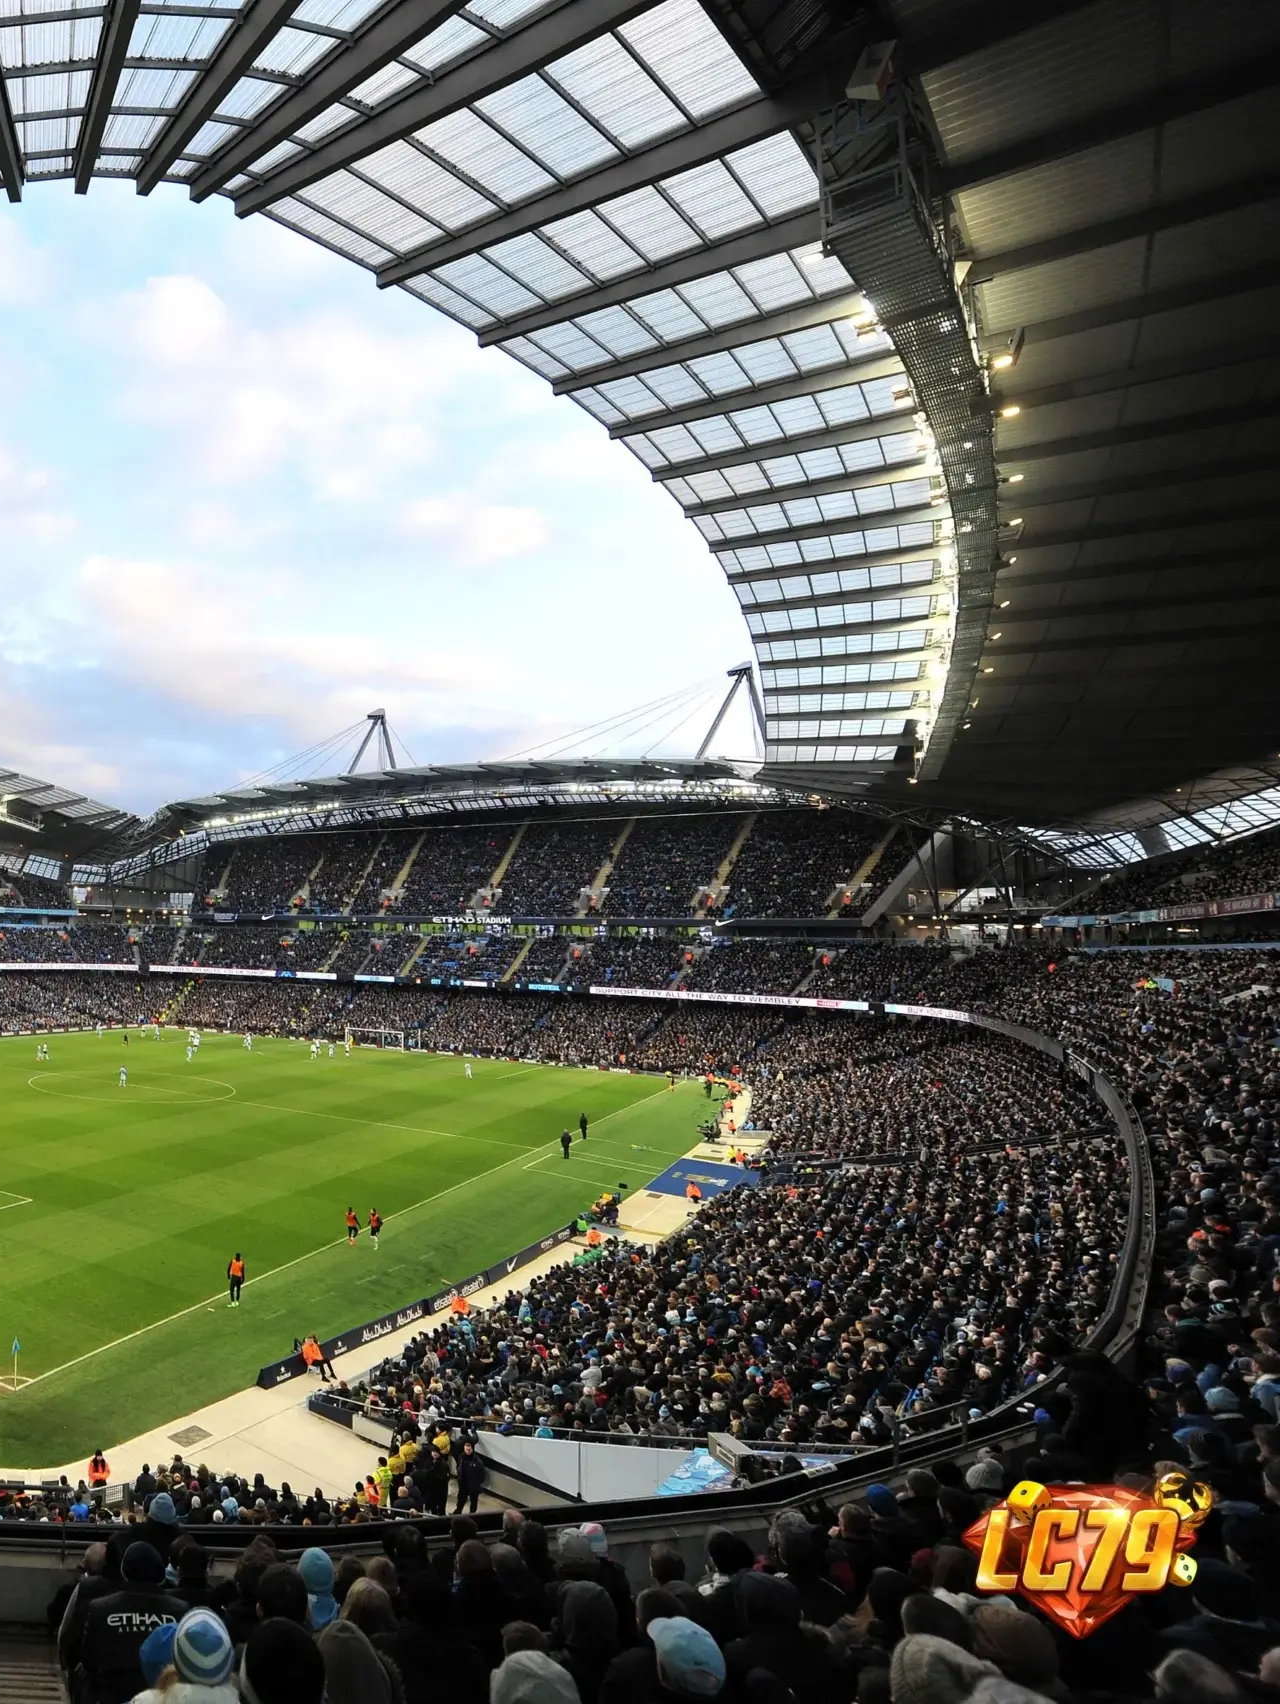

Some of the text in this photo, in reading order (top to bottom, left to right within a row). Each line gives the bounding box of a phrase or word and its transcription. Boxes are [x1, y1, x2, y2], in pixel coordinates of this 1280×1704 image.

[595, 988, 638, 996] SUPPORT
[708, 993, 730, 1001] WAY
[749, 996, 800, 1005] WEMBLEY
[907, 1006, 923, 1014] BUY
[107, 1613, 176, 1626] ETIHAD
